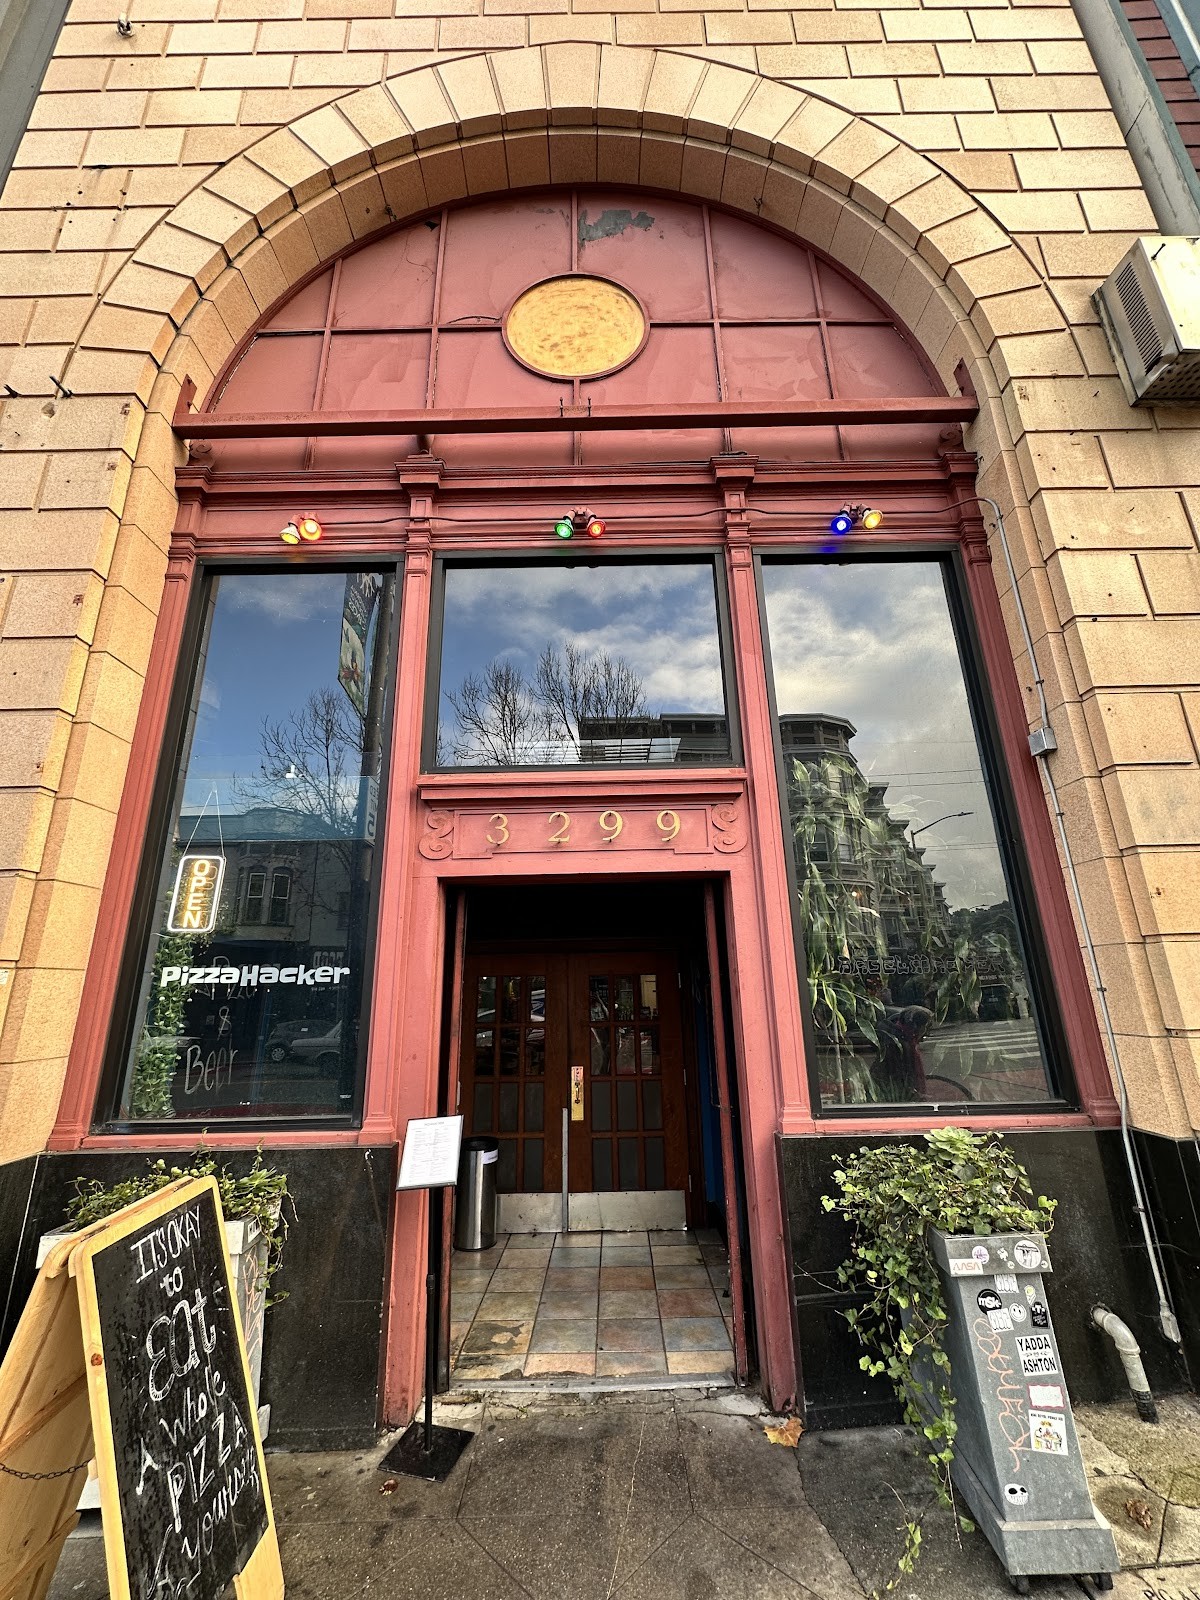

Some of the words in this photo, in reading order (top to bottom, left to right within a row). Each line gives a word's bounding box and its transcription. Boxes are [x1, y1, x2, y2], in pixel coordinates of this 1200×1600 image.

[486, 810, 681, 845] 3299
[183, 859, 211, 929] OPEN
[160, 964, 350, 988] PizzaHacker
[184, 1044, 239, 1096] Beer
[167, 1205, 200, 1258] OKAY
[160, 1266, 185, 1297] to
[1017, 1336, 1051, 1351] YADDA
[1023, 1357, 1057, 1373] ASHTON
[136, 1437, 161, 1496] A
[167, 1400, 248, 1533] PIZZA
